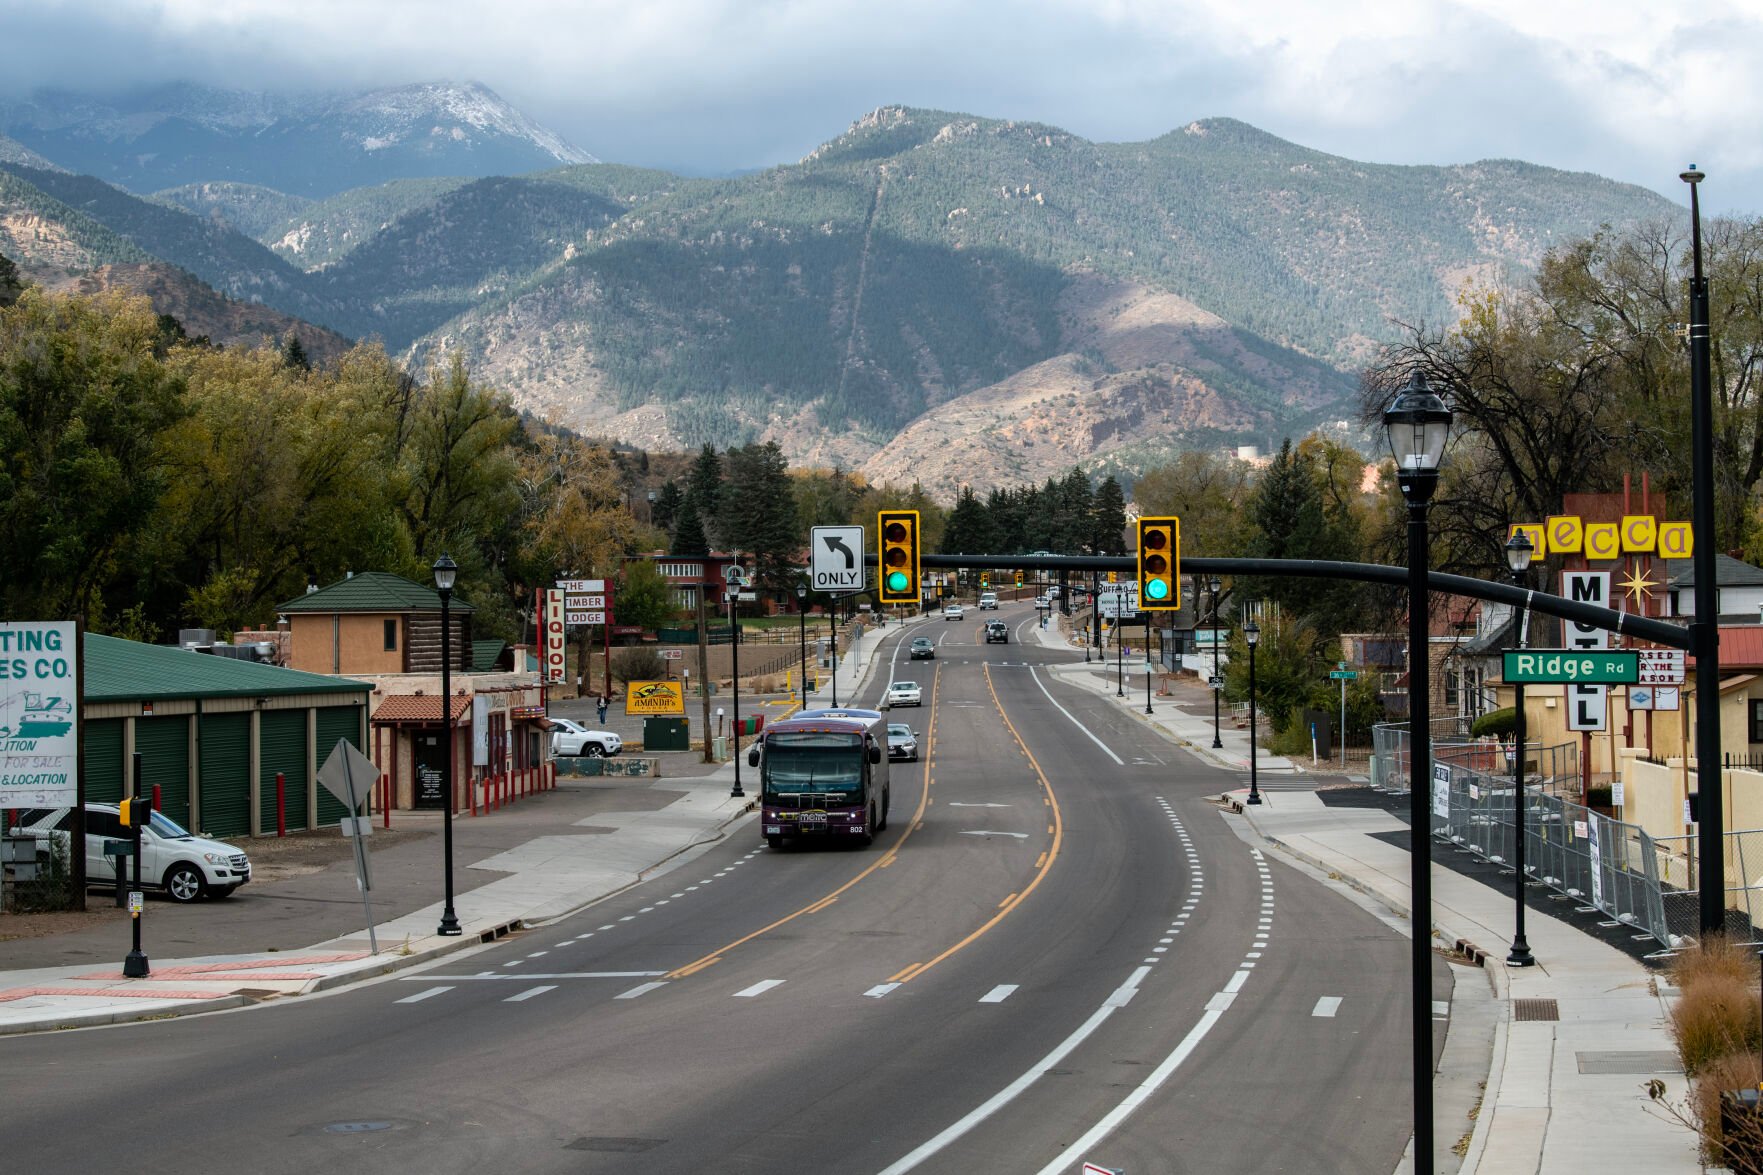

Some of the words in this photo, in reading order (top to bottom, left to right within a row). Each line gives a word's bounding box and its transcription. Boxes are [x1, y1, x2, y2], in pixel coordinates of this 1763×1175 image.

[817, 572, 858, 585] ONLY
[563, 582, 584, 591] THE
[1098, 584, 1128, 595] BUFFO
[566, 613, 601, 623] LODGE
[549, 591, 564, 680] LIQUOR
[1571, 576, 1601, 726] MTL
[34, 658, 72, 679] CO.
[1517, 655, 1595, 680] Ridge
[1605, 662, 1624, 673] Rd
[1653, 663, 1673, 671] THE
[1640, 674, 1674, 682] ASON
[4, 757, 29, 769] FOR
[32, 757, 63, 769] SALE
